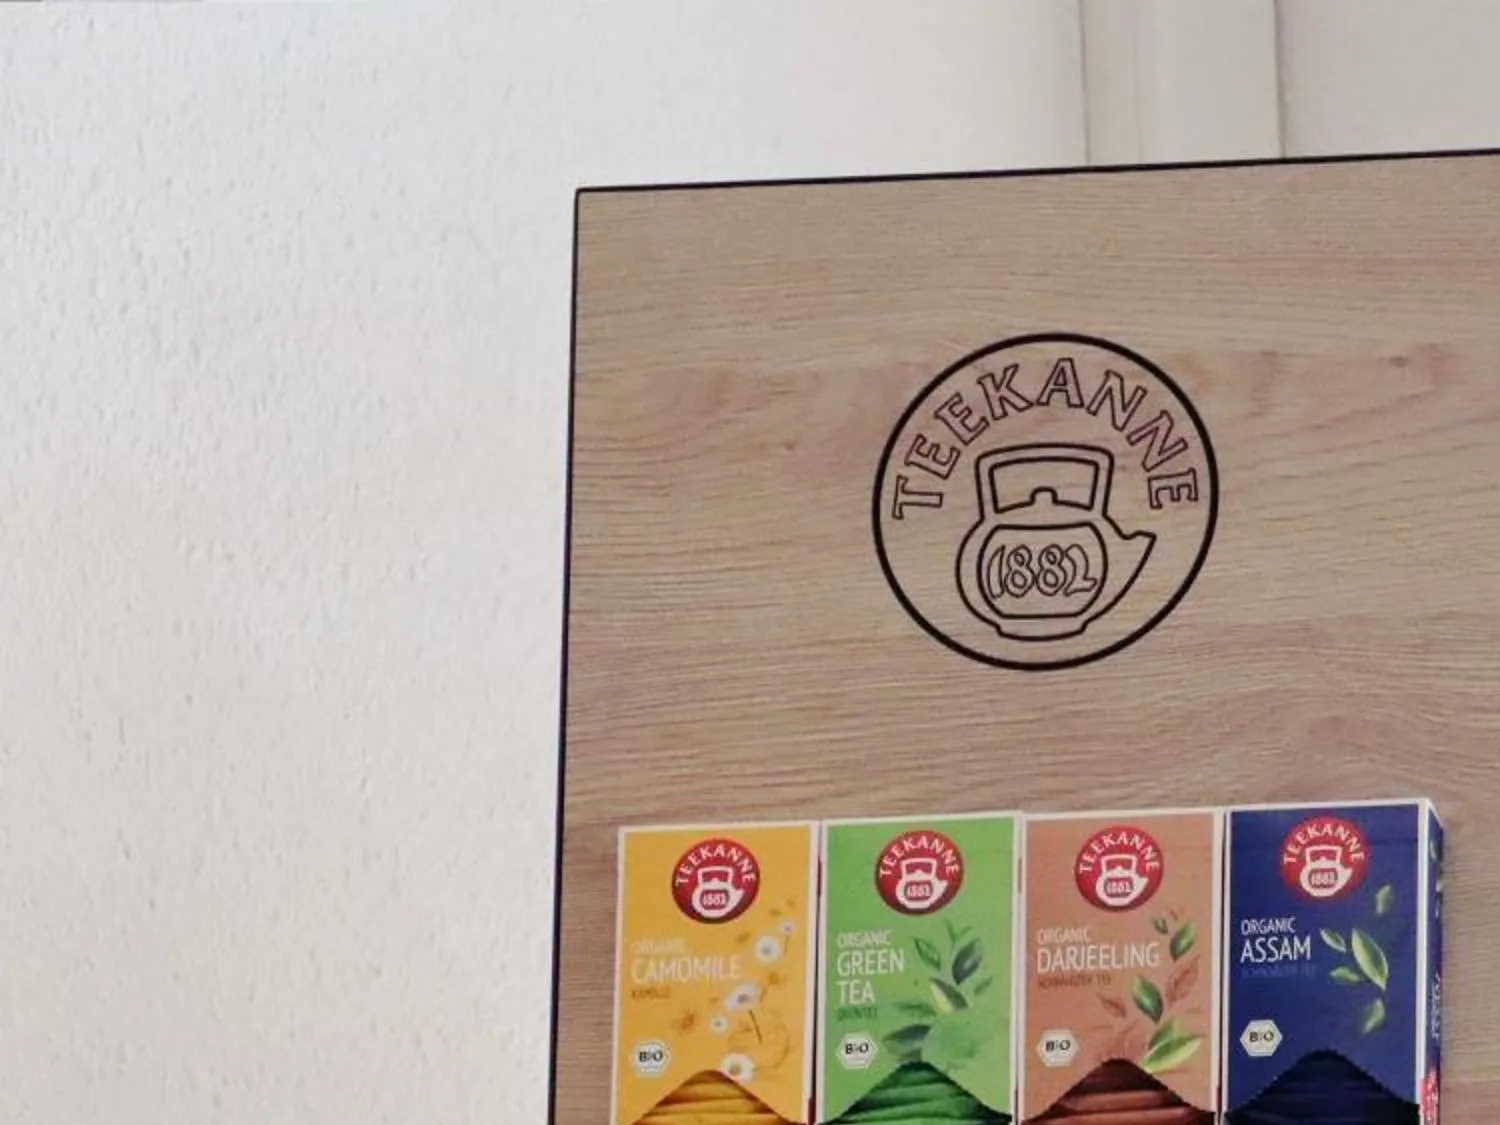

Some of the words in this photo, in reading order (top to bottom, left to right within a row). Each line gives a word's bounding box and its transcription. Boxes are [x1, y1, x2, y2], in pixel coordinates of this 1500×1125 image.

[892, 357, 1199, 520] TEEKANNE
[986, 543, 1097, 599] 1882
[879, 834, 961, 879] TEEKANNE
[1079, 830, 1159, 874] TEEKANNE
[1283, 822, 1365, 865] TEEKANNE
[674, 843, 757, 888] TEEKANNE
[1240, 916, 1296, 936] ORGANIC
[837, 948, 905, 977] GREEN
[1037, 941, 1161, 975] DARJEELING
[1240, 934, 1311, 963] ASSAM
[631, 954, 742, 984] CAMOMILE
[836, 979, 876, 1005] TEA
